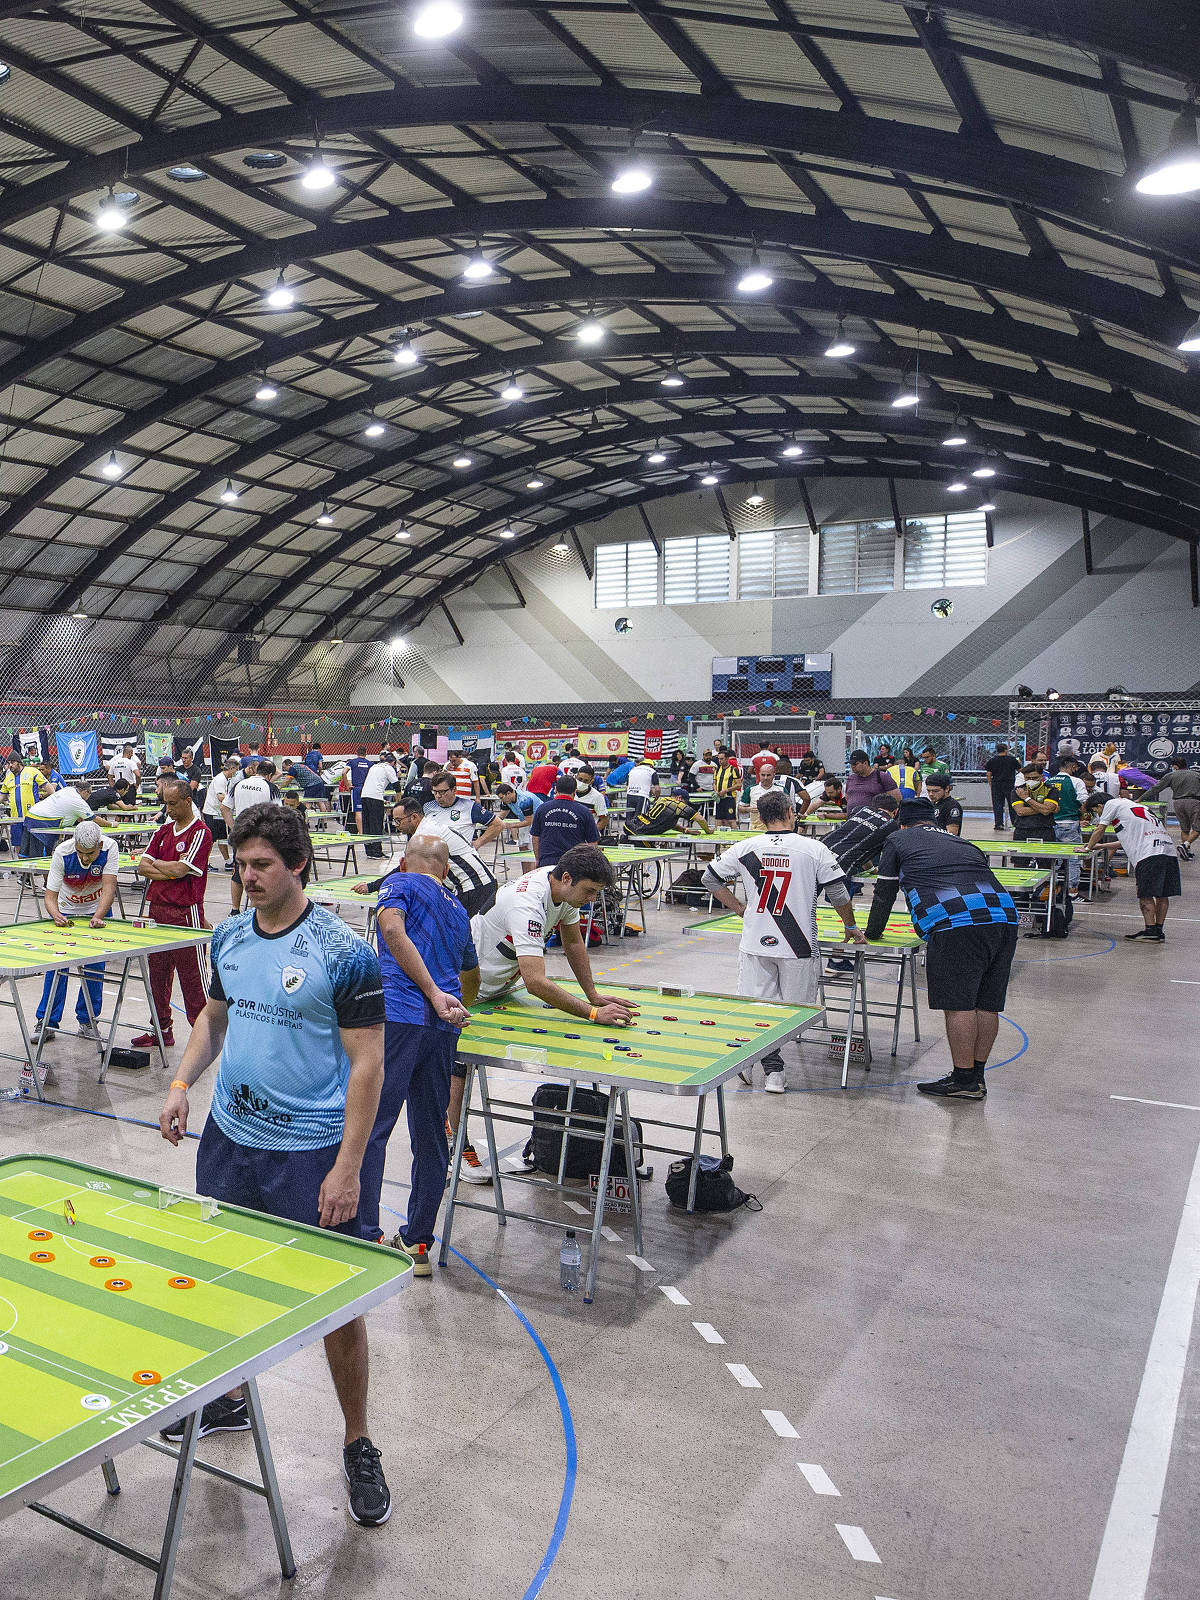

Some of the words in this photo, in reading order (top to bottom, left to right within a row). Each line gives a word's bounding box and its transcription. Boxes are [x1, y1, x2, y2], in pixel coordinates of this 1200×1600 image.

[241, 785, 262, 793] RAFAEL
[761, 857, 790, 868] RODOLFO
[756, 869, 792, 915] 77
[294, 933, 308, 950] Dr.
[235, 1008, 271, 1024] PLÁSTICOS
[277, 1020, 303, 1030] METAIS
[237, 998, 256, 1011] GVR
[257, 1001, 303, 1021] INDÚSTRIA
